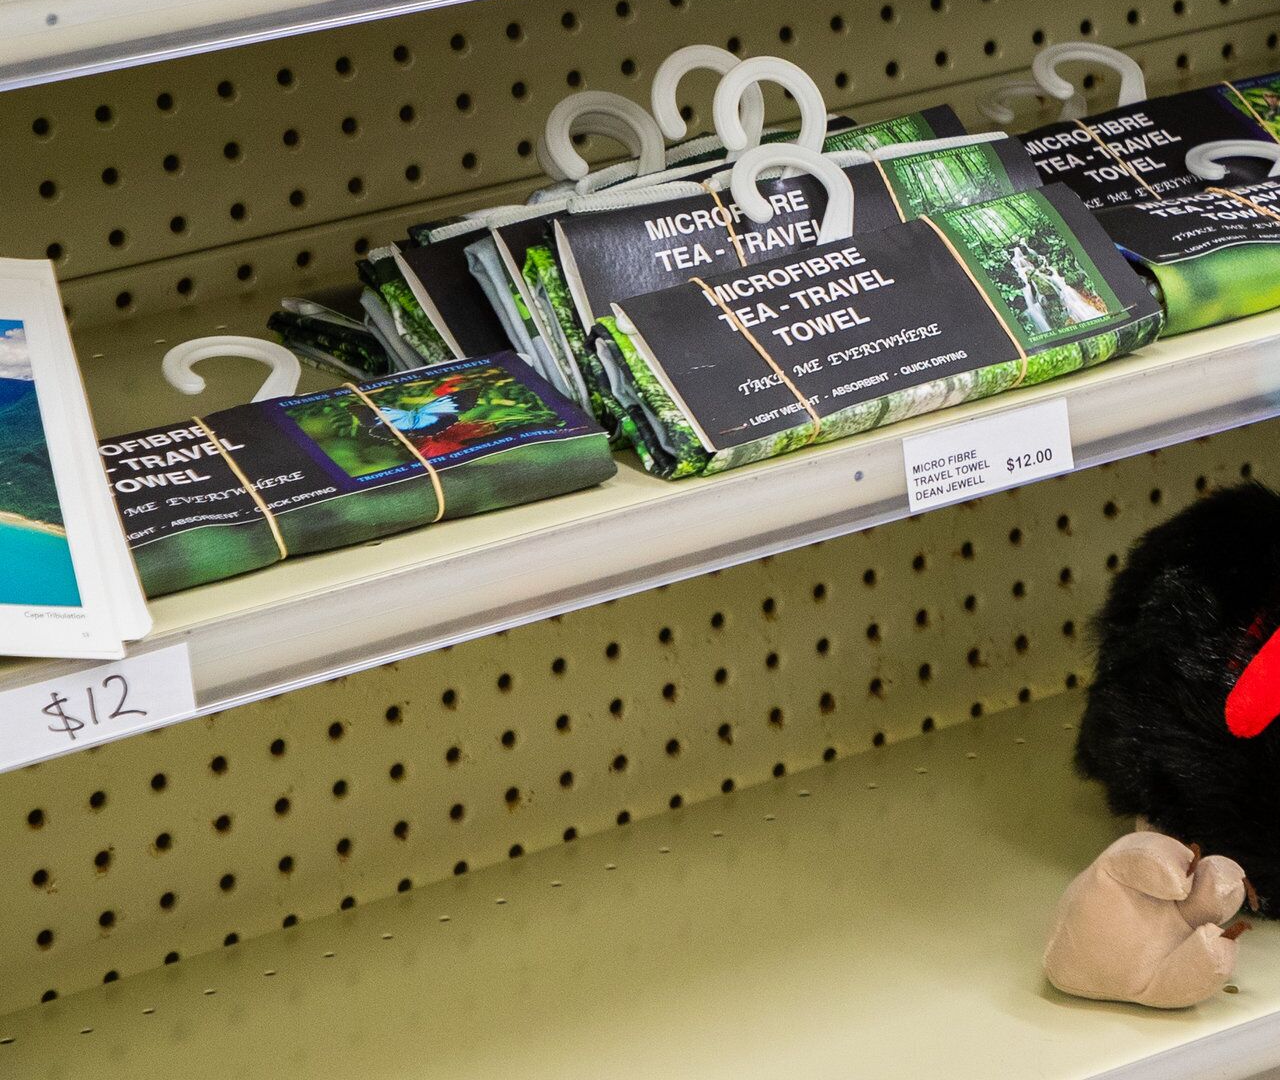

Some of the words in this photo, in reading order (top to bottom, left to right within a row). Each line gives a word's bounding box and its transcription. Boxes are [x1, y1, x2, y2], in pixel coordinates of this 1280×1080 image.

[1025, 112, 1154, 156] MICROFIBRE
[893, 155, 932, 167] DAINTREE
[934, 145, 980, 159] RAINFOREST
[1034, 153, 1085, 175] TEA
[1093, 129, 1182, 159] TRAVEL
[1083, 157, 1167, 184] TOWEL
[1107, 190, 1131, 204] ME
[643, 190, 810, 241] MICROFRE
[1149, 204, 1204, 219] TEA
[655, 245, 712, 272] TEA
[1183, 241, 1211, 254] LIGHT
[702, 247, 867, 307] MICROFIBRE
[717, 304, 777, 332] TEA
[788, 268, 895, 311] TRAVEL
[772, 306, 871, 347] TOWEL
[792, 359, 823, 379] ME
[826, 323, 942, 366] EVERYWHERE
[426, 358, 493, 381] BUTTERFLY
[749, 410, 780, 426] LIGHT
[831, 372, 889, 398] ABSORBENT
[899, 359, 931, 376] QUICK
[929, 350, 968, 371] DRYING
[119, 438, 245, 470] TRAVEL
[912, 458, 946, 474] MICRO
[948, 450, 977, 465] FIBRE
[1006, 448, 1052, 473] $12.00
[109, 470, 211, 494] OWEL
[356, 467, 409, 483] TROPICAL
[914, 470, 953, 487] TRAVEL
[955, 460, 990, 477] TOWEL
[124, 501, 160, 518] ME
[166, 471, 305, 507] EVERYWHERE
[915, 484, 944, 501] DEAN
[946, 475, 985, 493] JEWELL
[170, 510, 239, 527] ABSORBENT
[291, 487, 337, 503] DRYING
[24, 611, 44, 619] Cape
[45, 611, 86, 619] Tribulation
[42, 674, 147, 740] $12
